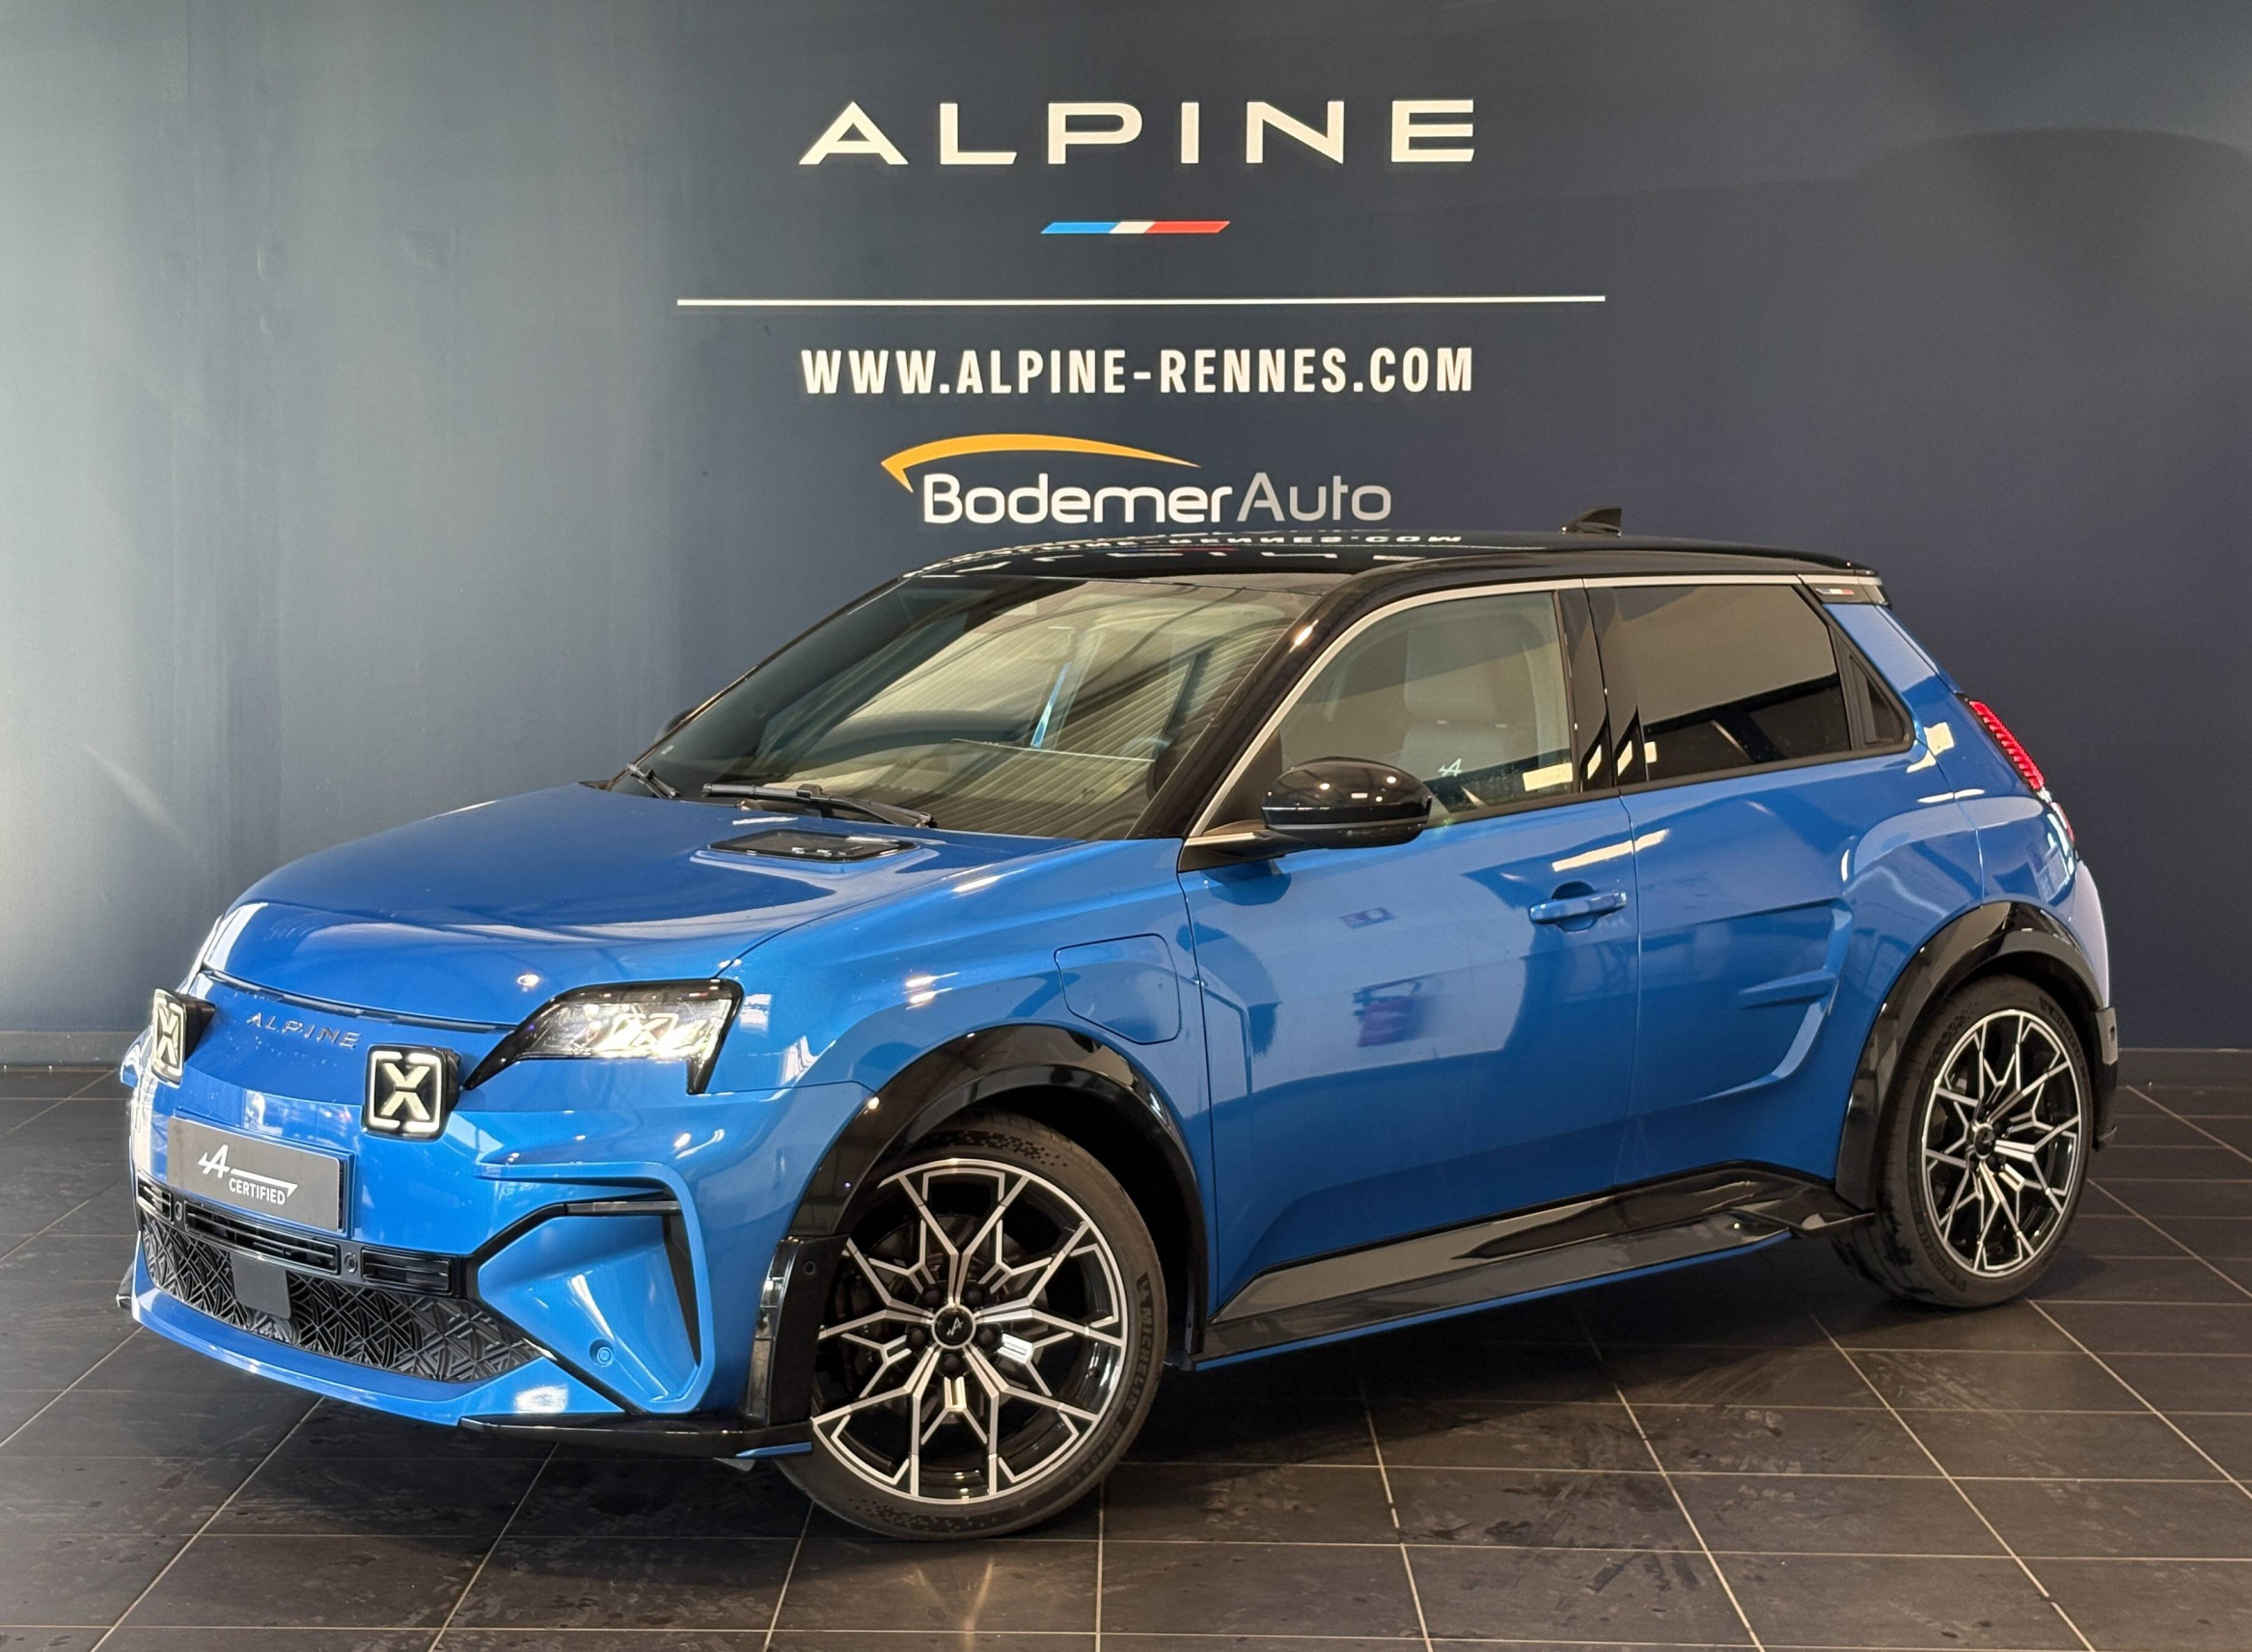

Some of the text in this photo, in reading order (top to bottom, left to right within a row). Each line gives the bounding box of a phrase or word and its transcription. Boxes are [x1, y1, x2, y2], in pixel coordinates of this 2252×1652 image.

[798, 98, 1476, 166] ALPINE
[800, 346, 1473, 396] WWW.ALPINE-RENNES.COM
[247, 1013, 361, 1049] ALPINE
[229, 1178, 286, 1205] CERTIFIED
[1125, 1307, 1154, 1411] MICHELIN
